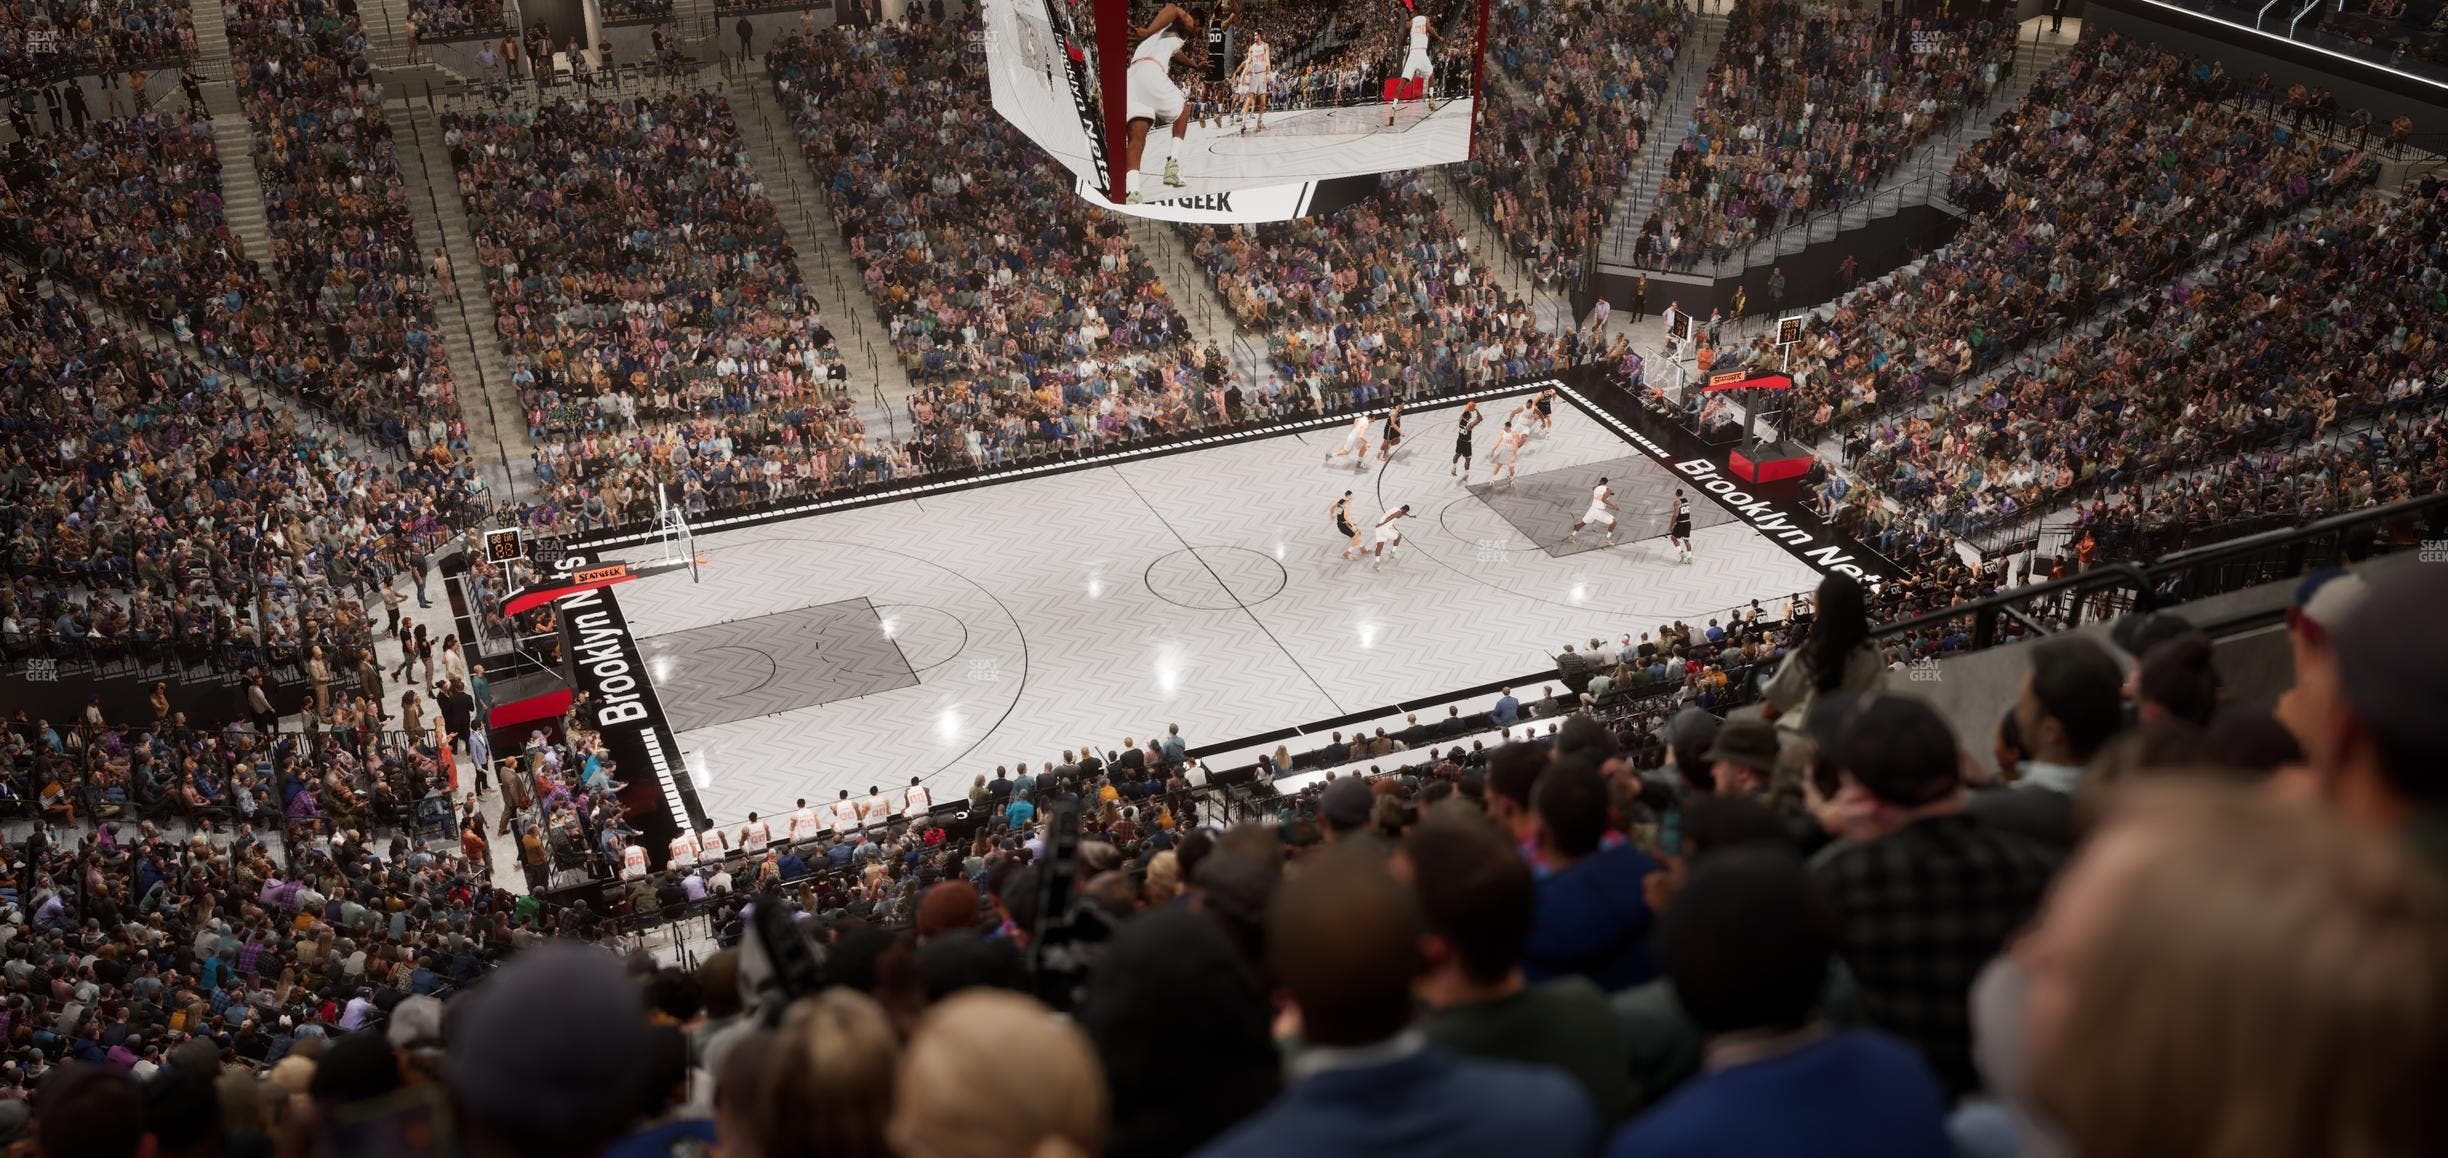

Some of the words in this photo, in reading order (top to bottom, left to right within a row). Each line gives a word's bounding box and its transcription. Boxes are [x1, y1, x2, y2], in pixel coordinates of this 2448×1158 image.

[1209, 33, 1222, 42] 00
[1674, 458, 1814, 546] Brooklyn
[578, 567, 622, 582] SEATGEEK
[573, 610, 648, 726] Brooklyn
